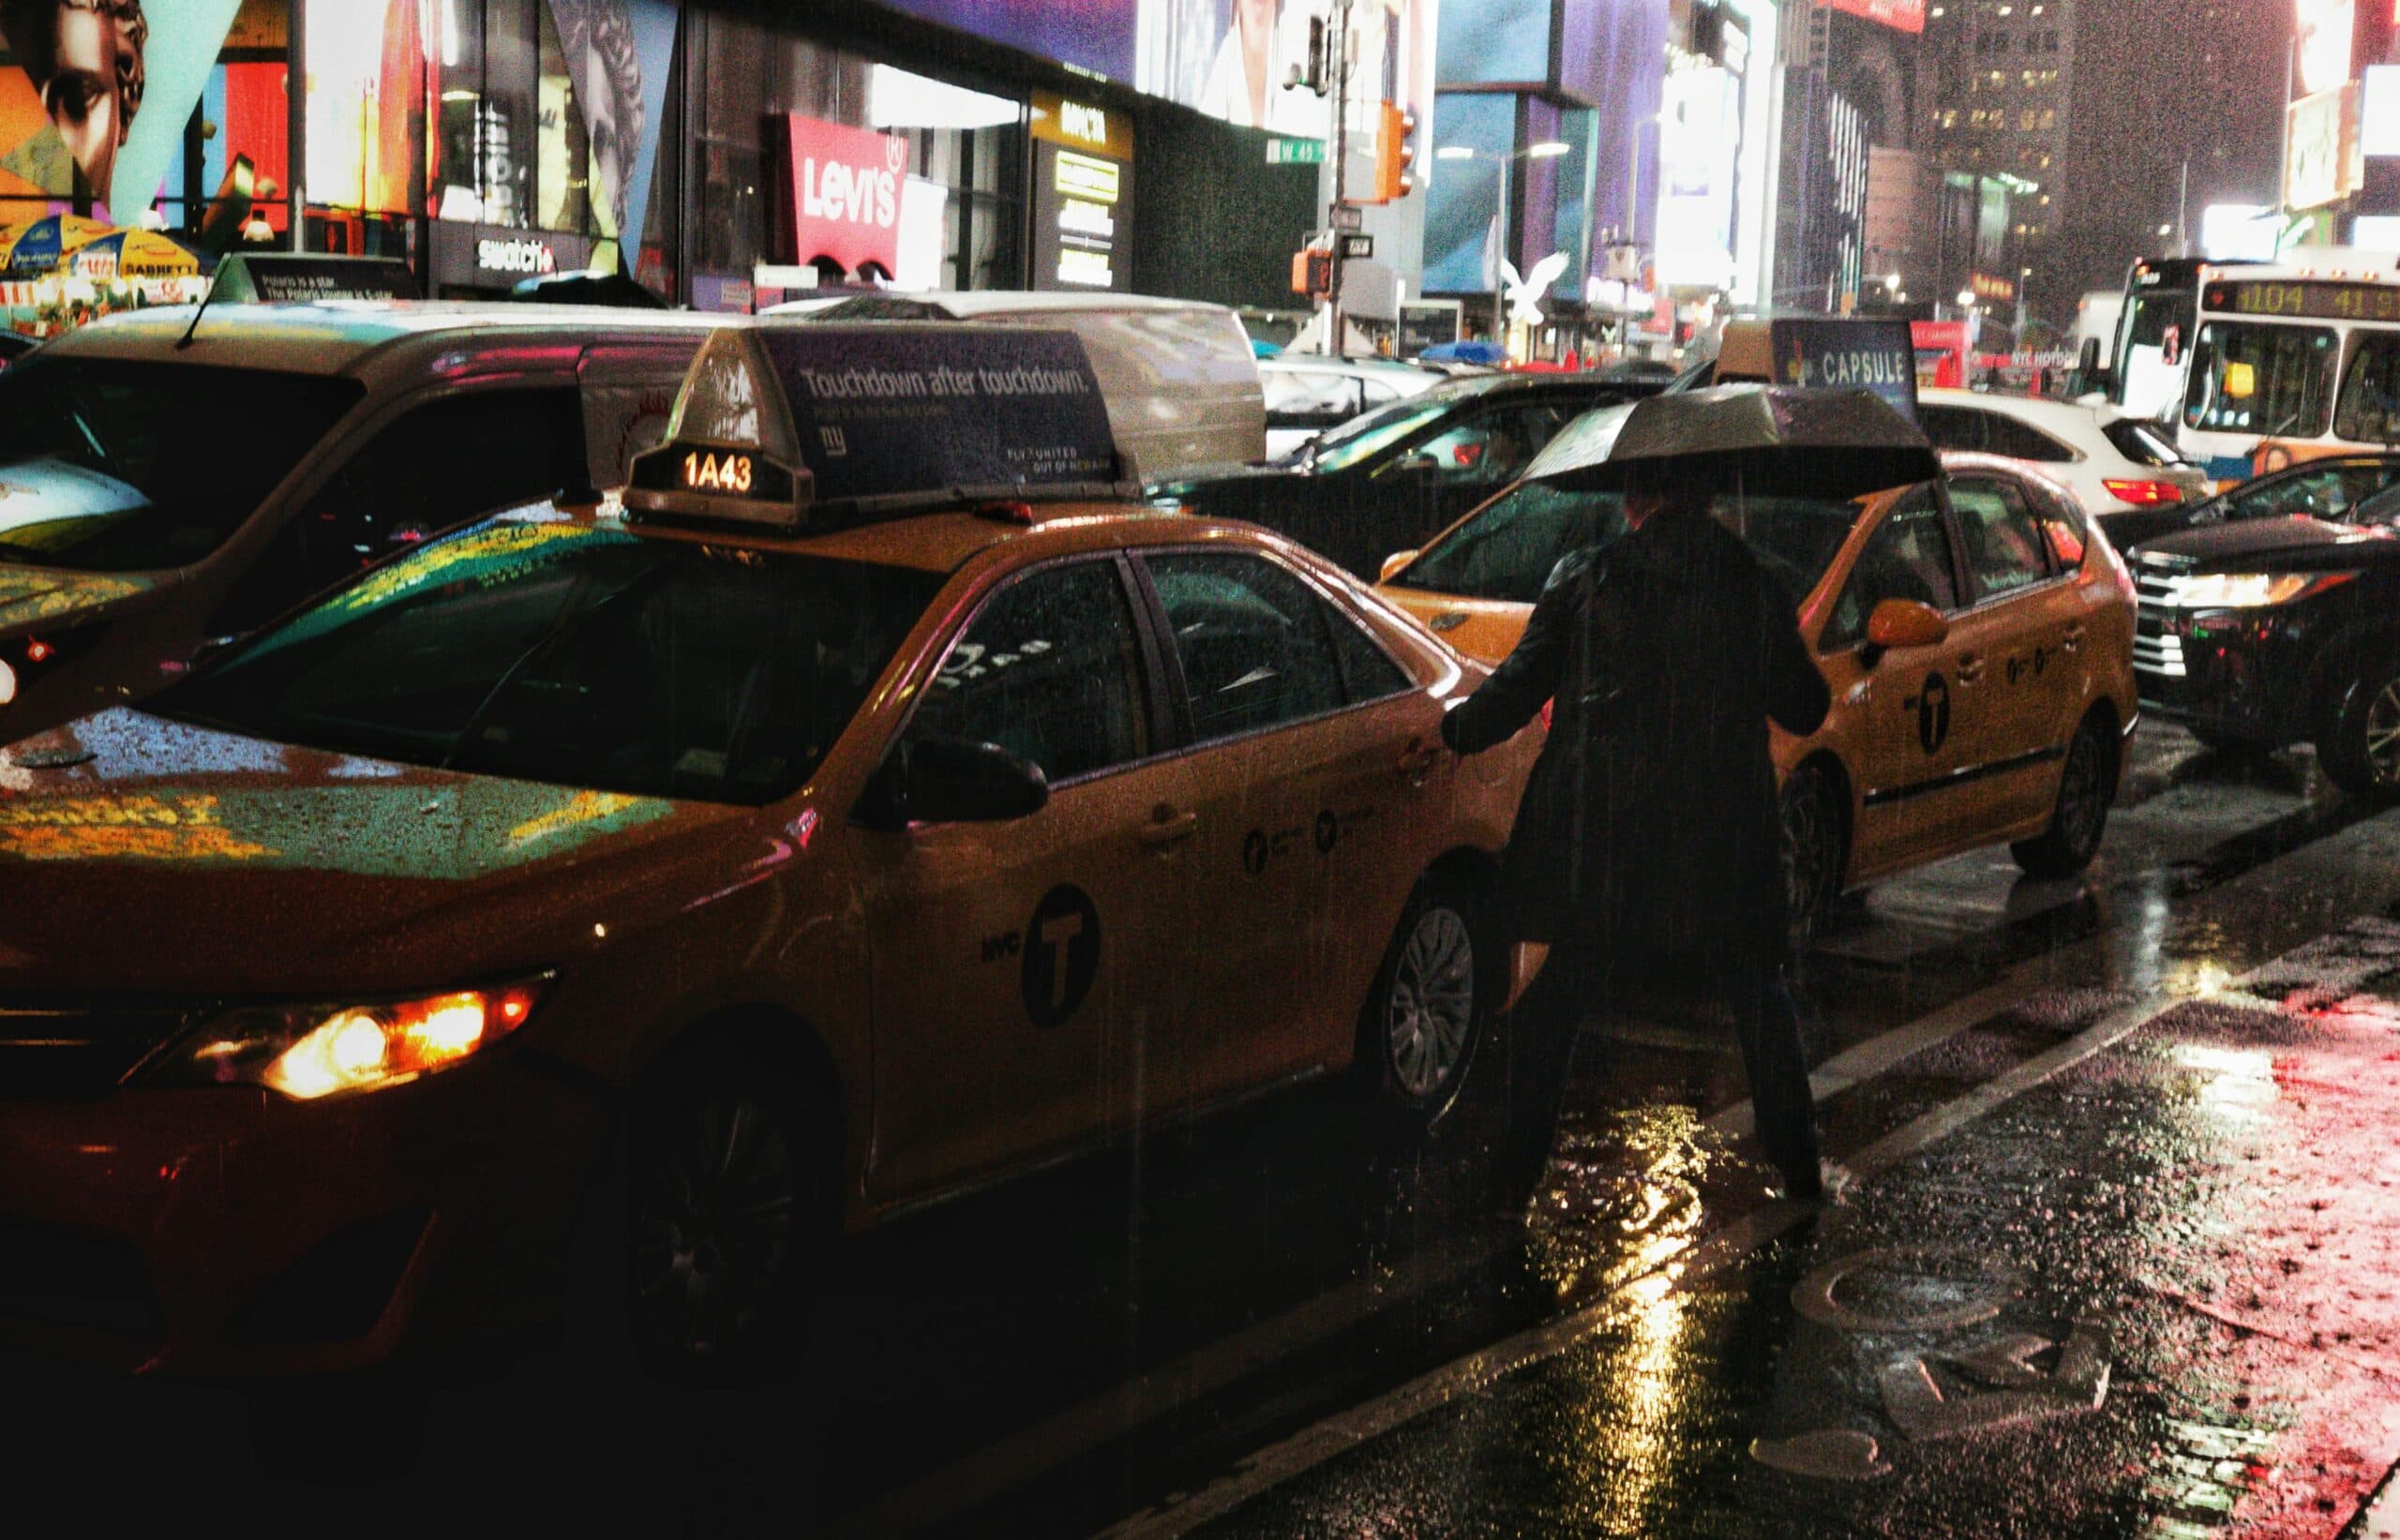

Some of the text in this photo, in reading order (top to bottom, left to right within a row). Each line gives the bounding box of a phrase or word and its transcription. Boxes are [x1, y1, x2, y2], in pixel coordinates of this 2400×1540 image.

[802, 366, 1088, 398] Touchdown after touchdown.
[1822, 351, 1906, 385] CAPSULE
[684, 450, 752, 492] 1A43
